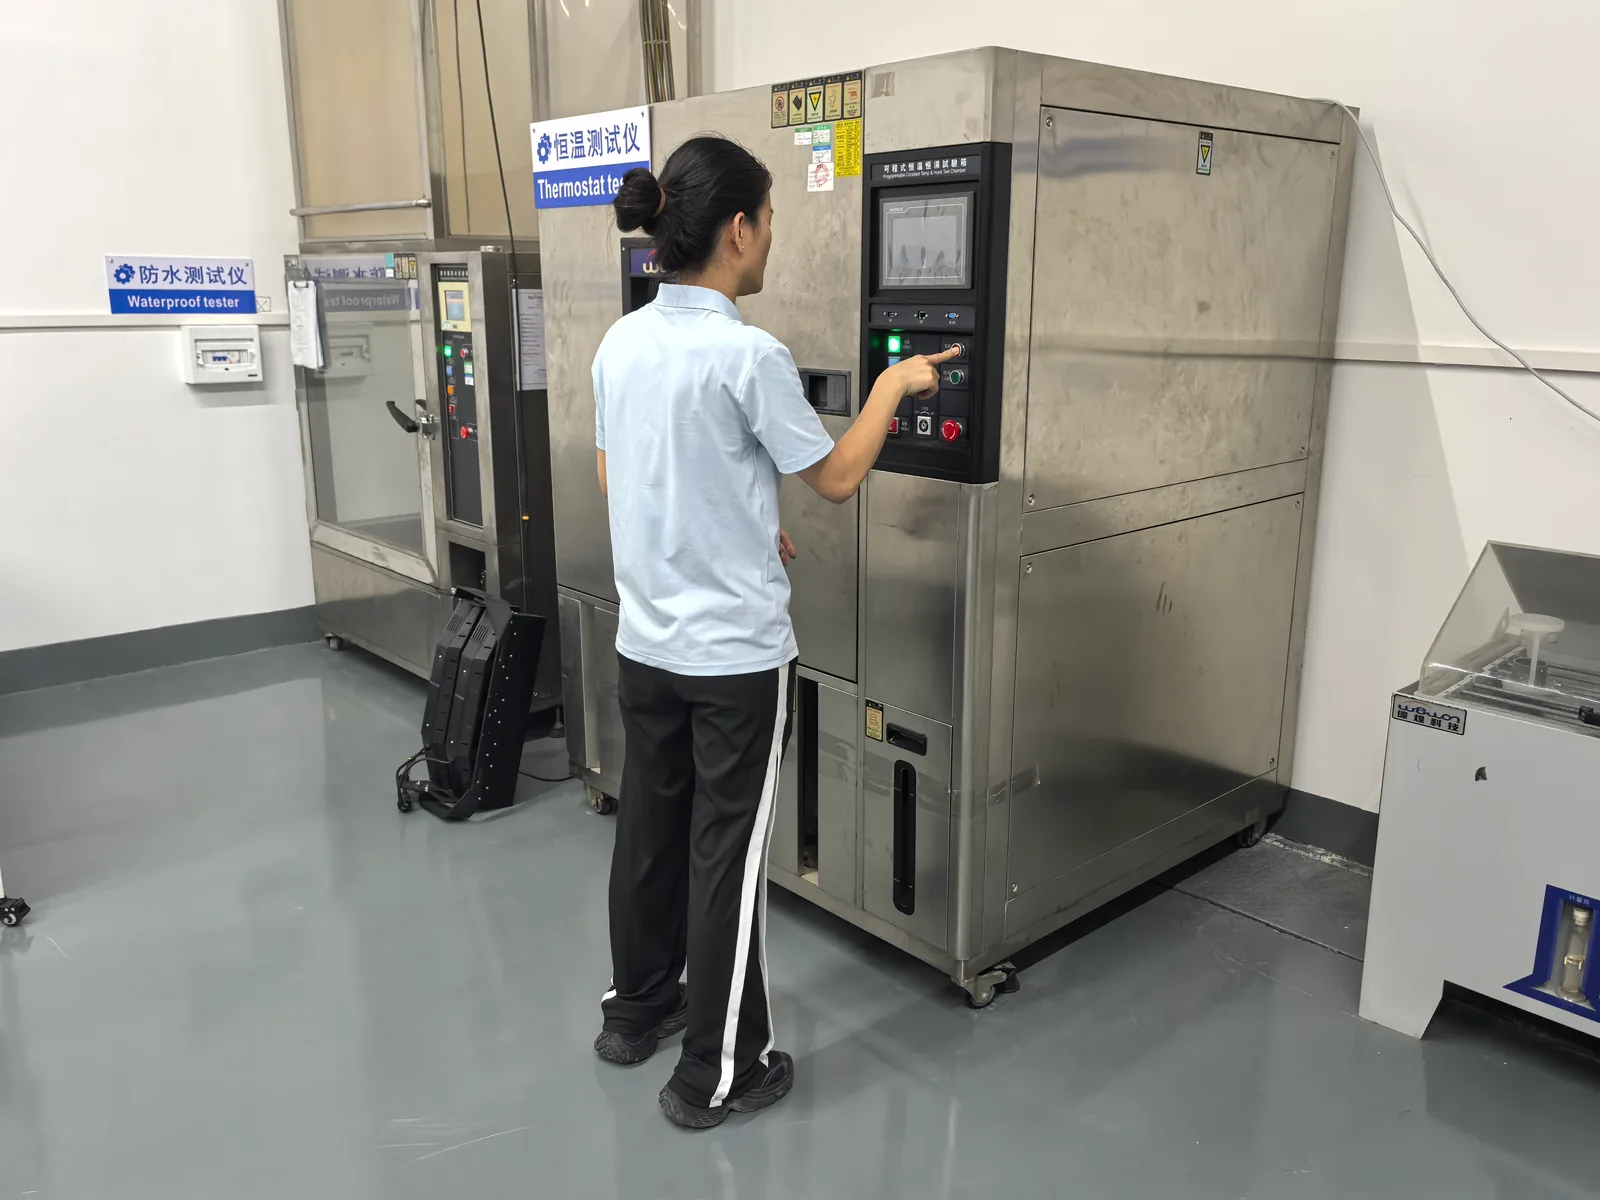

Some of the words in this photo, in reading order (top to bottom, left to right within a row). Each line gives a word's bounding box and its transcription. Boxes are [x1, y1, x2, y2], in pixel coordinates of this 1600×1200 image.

[554, 122, 641, 161] 恒温测试仪
[537, 174, 605, 199] Thermostat
[139, 264, 247, 285] 防水测试仪
[127, 295, 201, 310] Waterproof
[203, 296, 239, 308] tester
